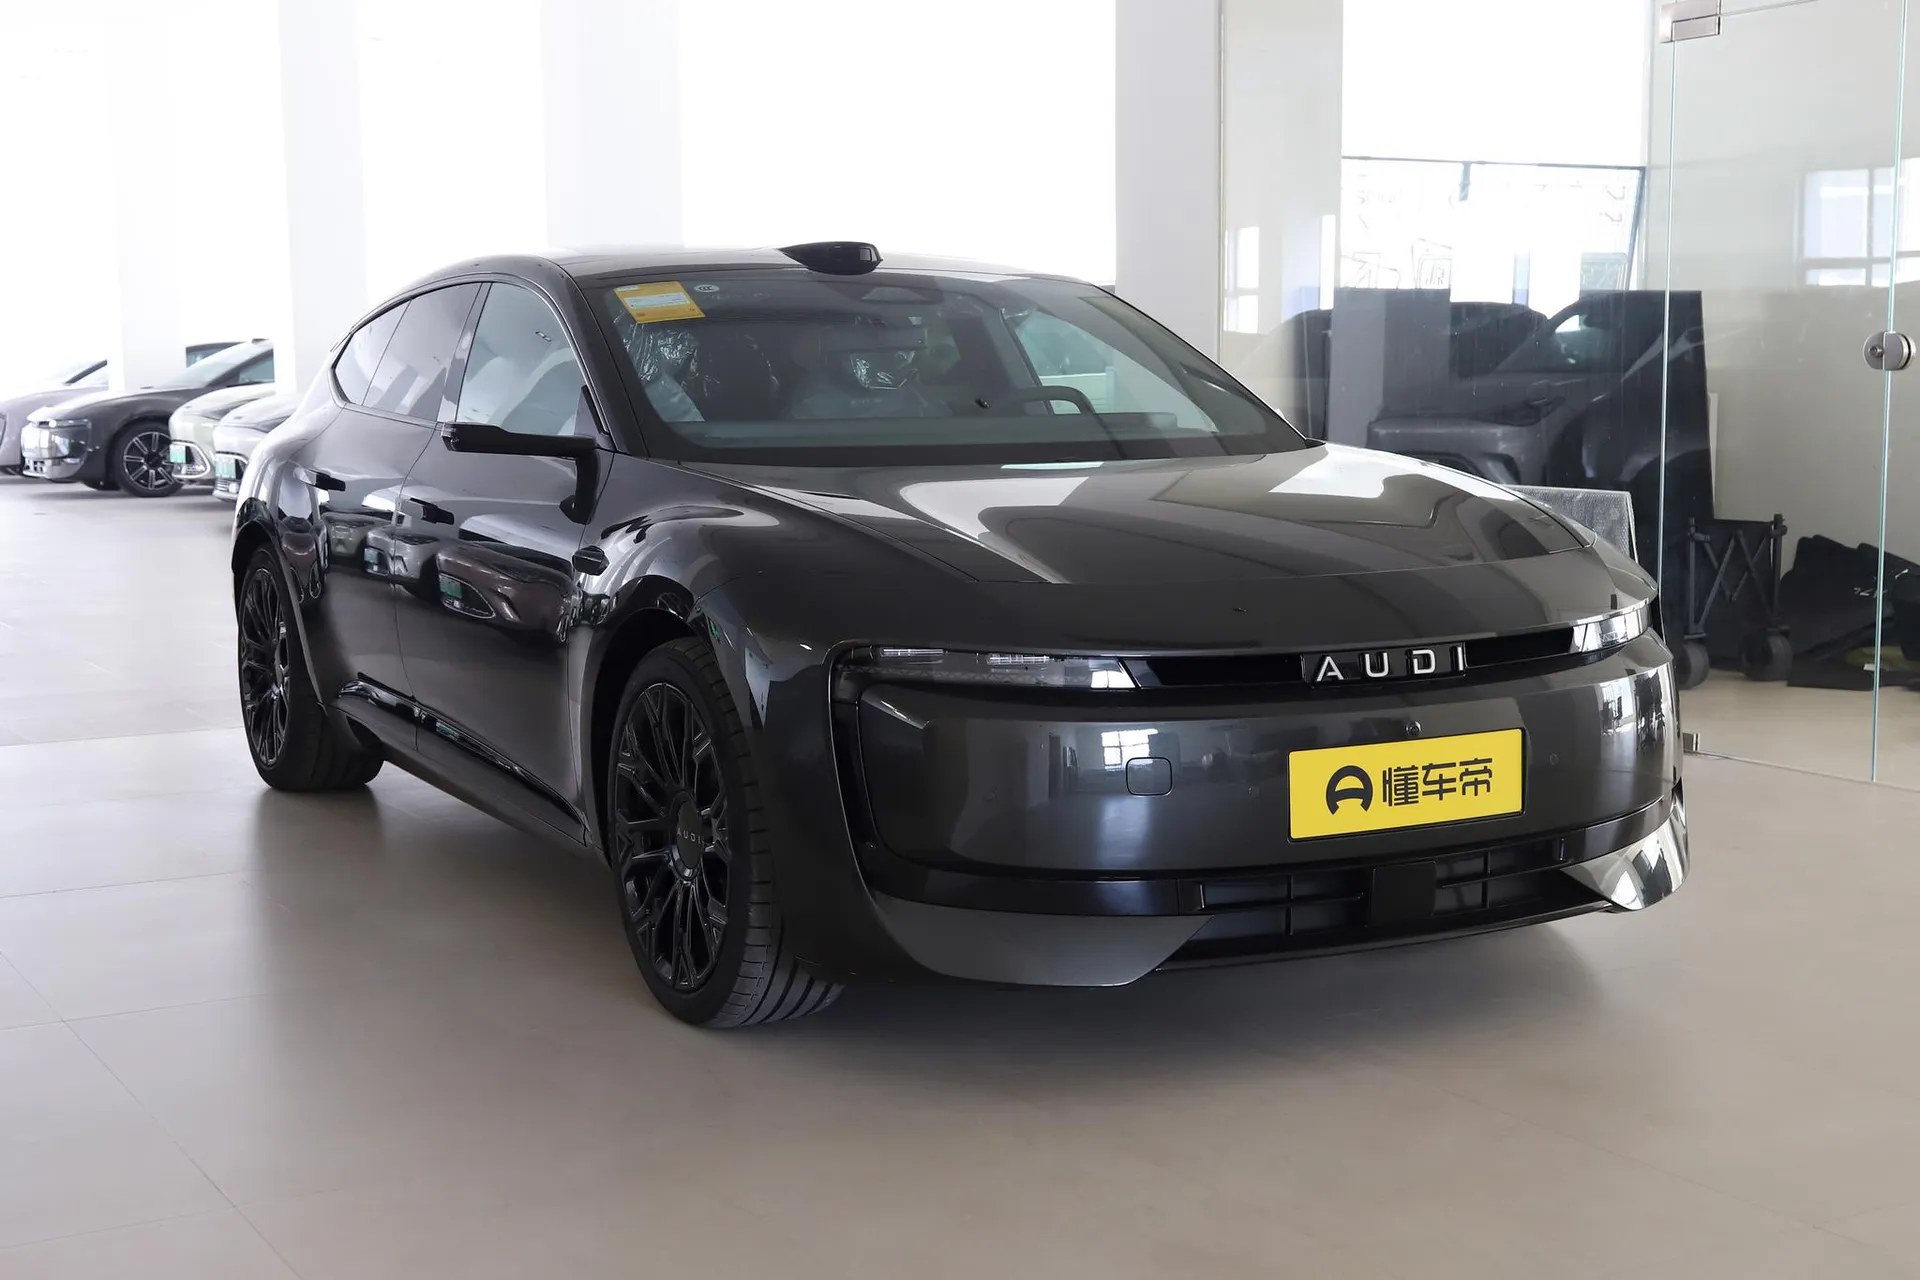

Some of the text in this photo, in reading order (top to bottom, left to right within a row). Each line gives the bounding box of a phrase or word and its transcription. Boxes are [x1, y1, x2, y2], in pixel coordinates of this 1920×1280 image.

[1316, 646, 1465, 682] AUDI
[1382, 757, 1493, 807] 懂车帝
[676, 827, 701, 845] AUDI
